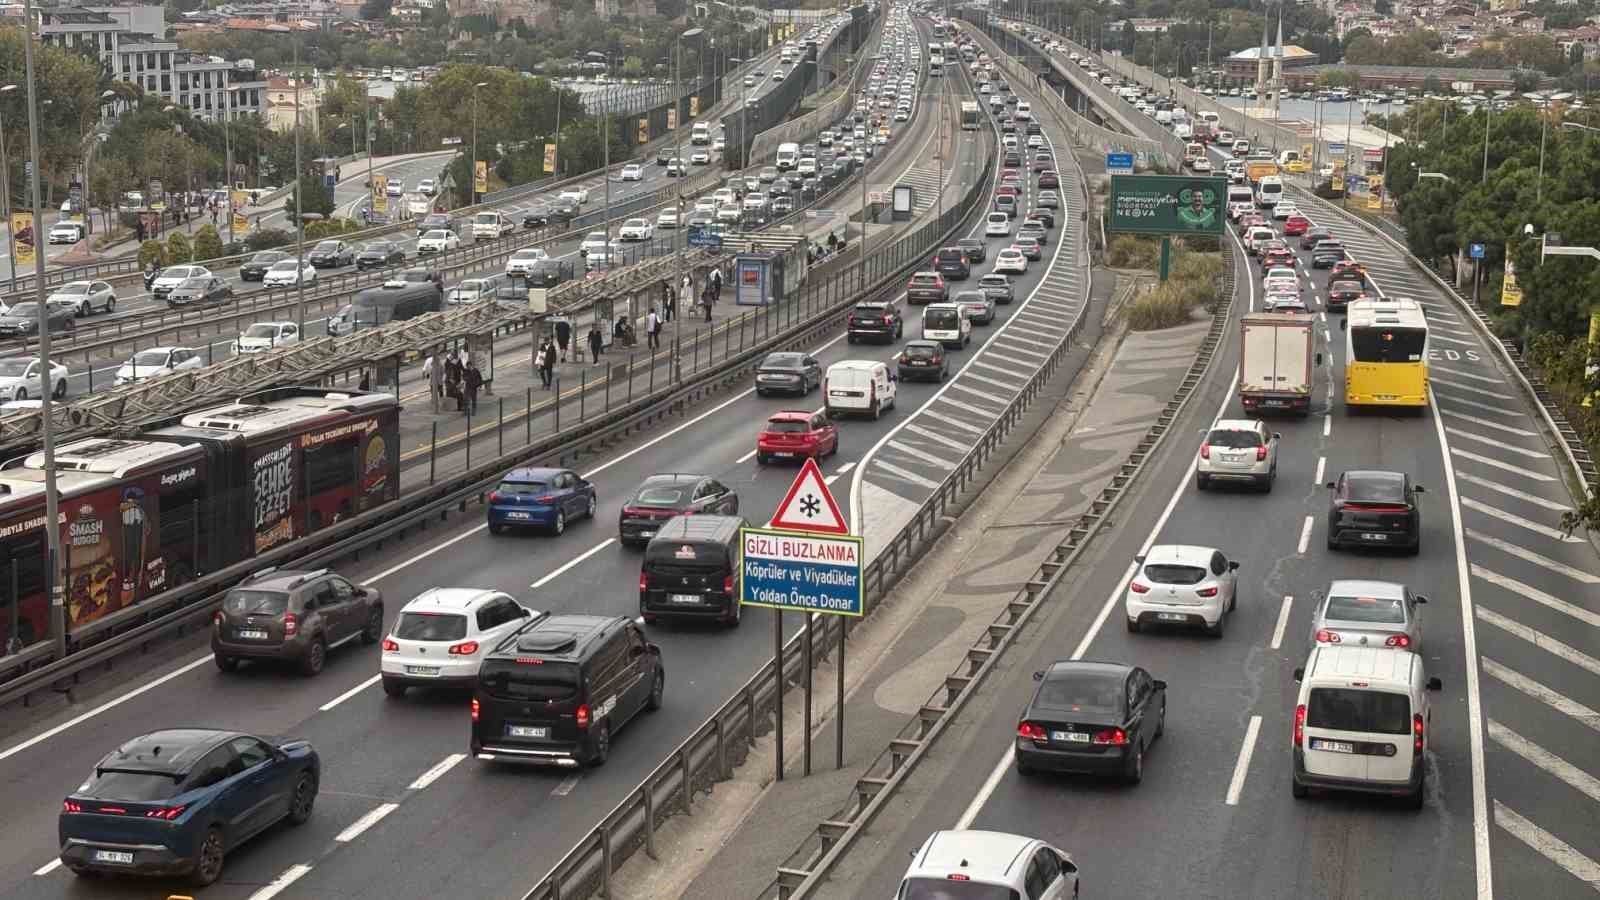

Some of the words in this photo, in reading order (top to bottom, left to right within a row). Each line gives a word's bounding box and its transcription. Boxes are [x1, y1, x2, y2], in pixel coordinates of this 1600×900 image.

[1428, 349, 1481, 361] EDS
[68, 519, 103, 537] SMASH
[747, 535, 779, 556] GİZLİ
[783, 541, 855, 562] BUZLANMA
[745, 561, 787, 581] Köprüler
[789, 570, 801, 581] ve
[803, 567, 857, 587] Viyadükler
[751, 586, 788, 604] Yoldan
[790, 587, 818, 606] Önce
[820, 593, 853, 610] Donar
